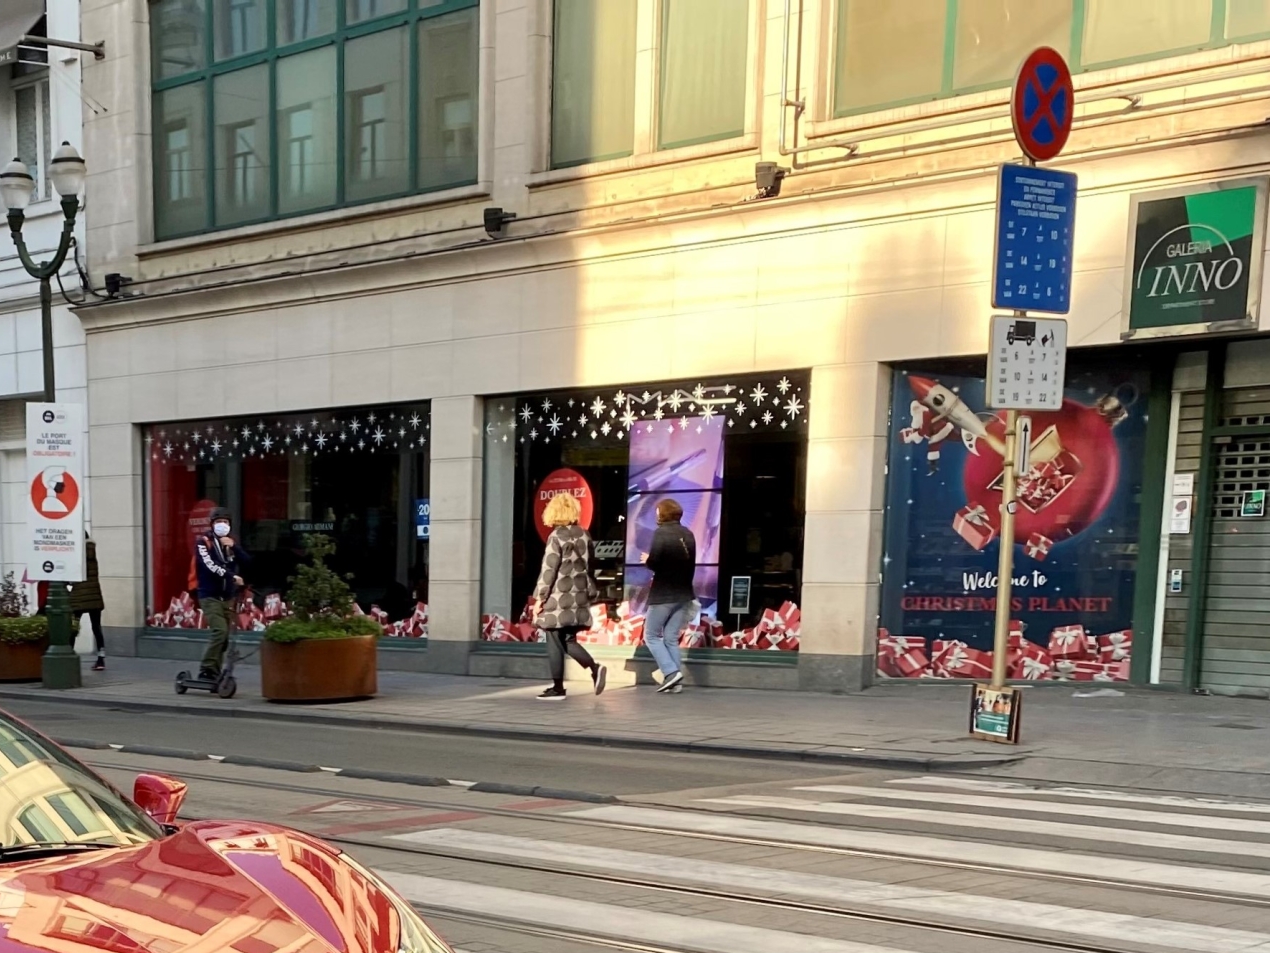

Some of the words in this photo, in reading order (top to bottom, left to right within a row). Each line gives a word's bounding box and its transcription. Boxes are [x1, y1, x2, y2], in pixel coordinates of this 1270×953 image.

[1166, 240, 1212, 258] GALERIA
[1146, 257, 1243, 297] INNO
[1018, 284, 1027, 294] 22
[962, 571, 1030, 591] Welcme
[1032, 569, 1048, 588] to
[900, 596, 1023, 611] CHRISTMS
[1028, 597, 1113, 612] PLANET
